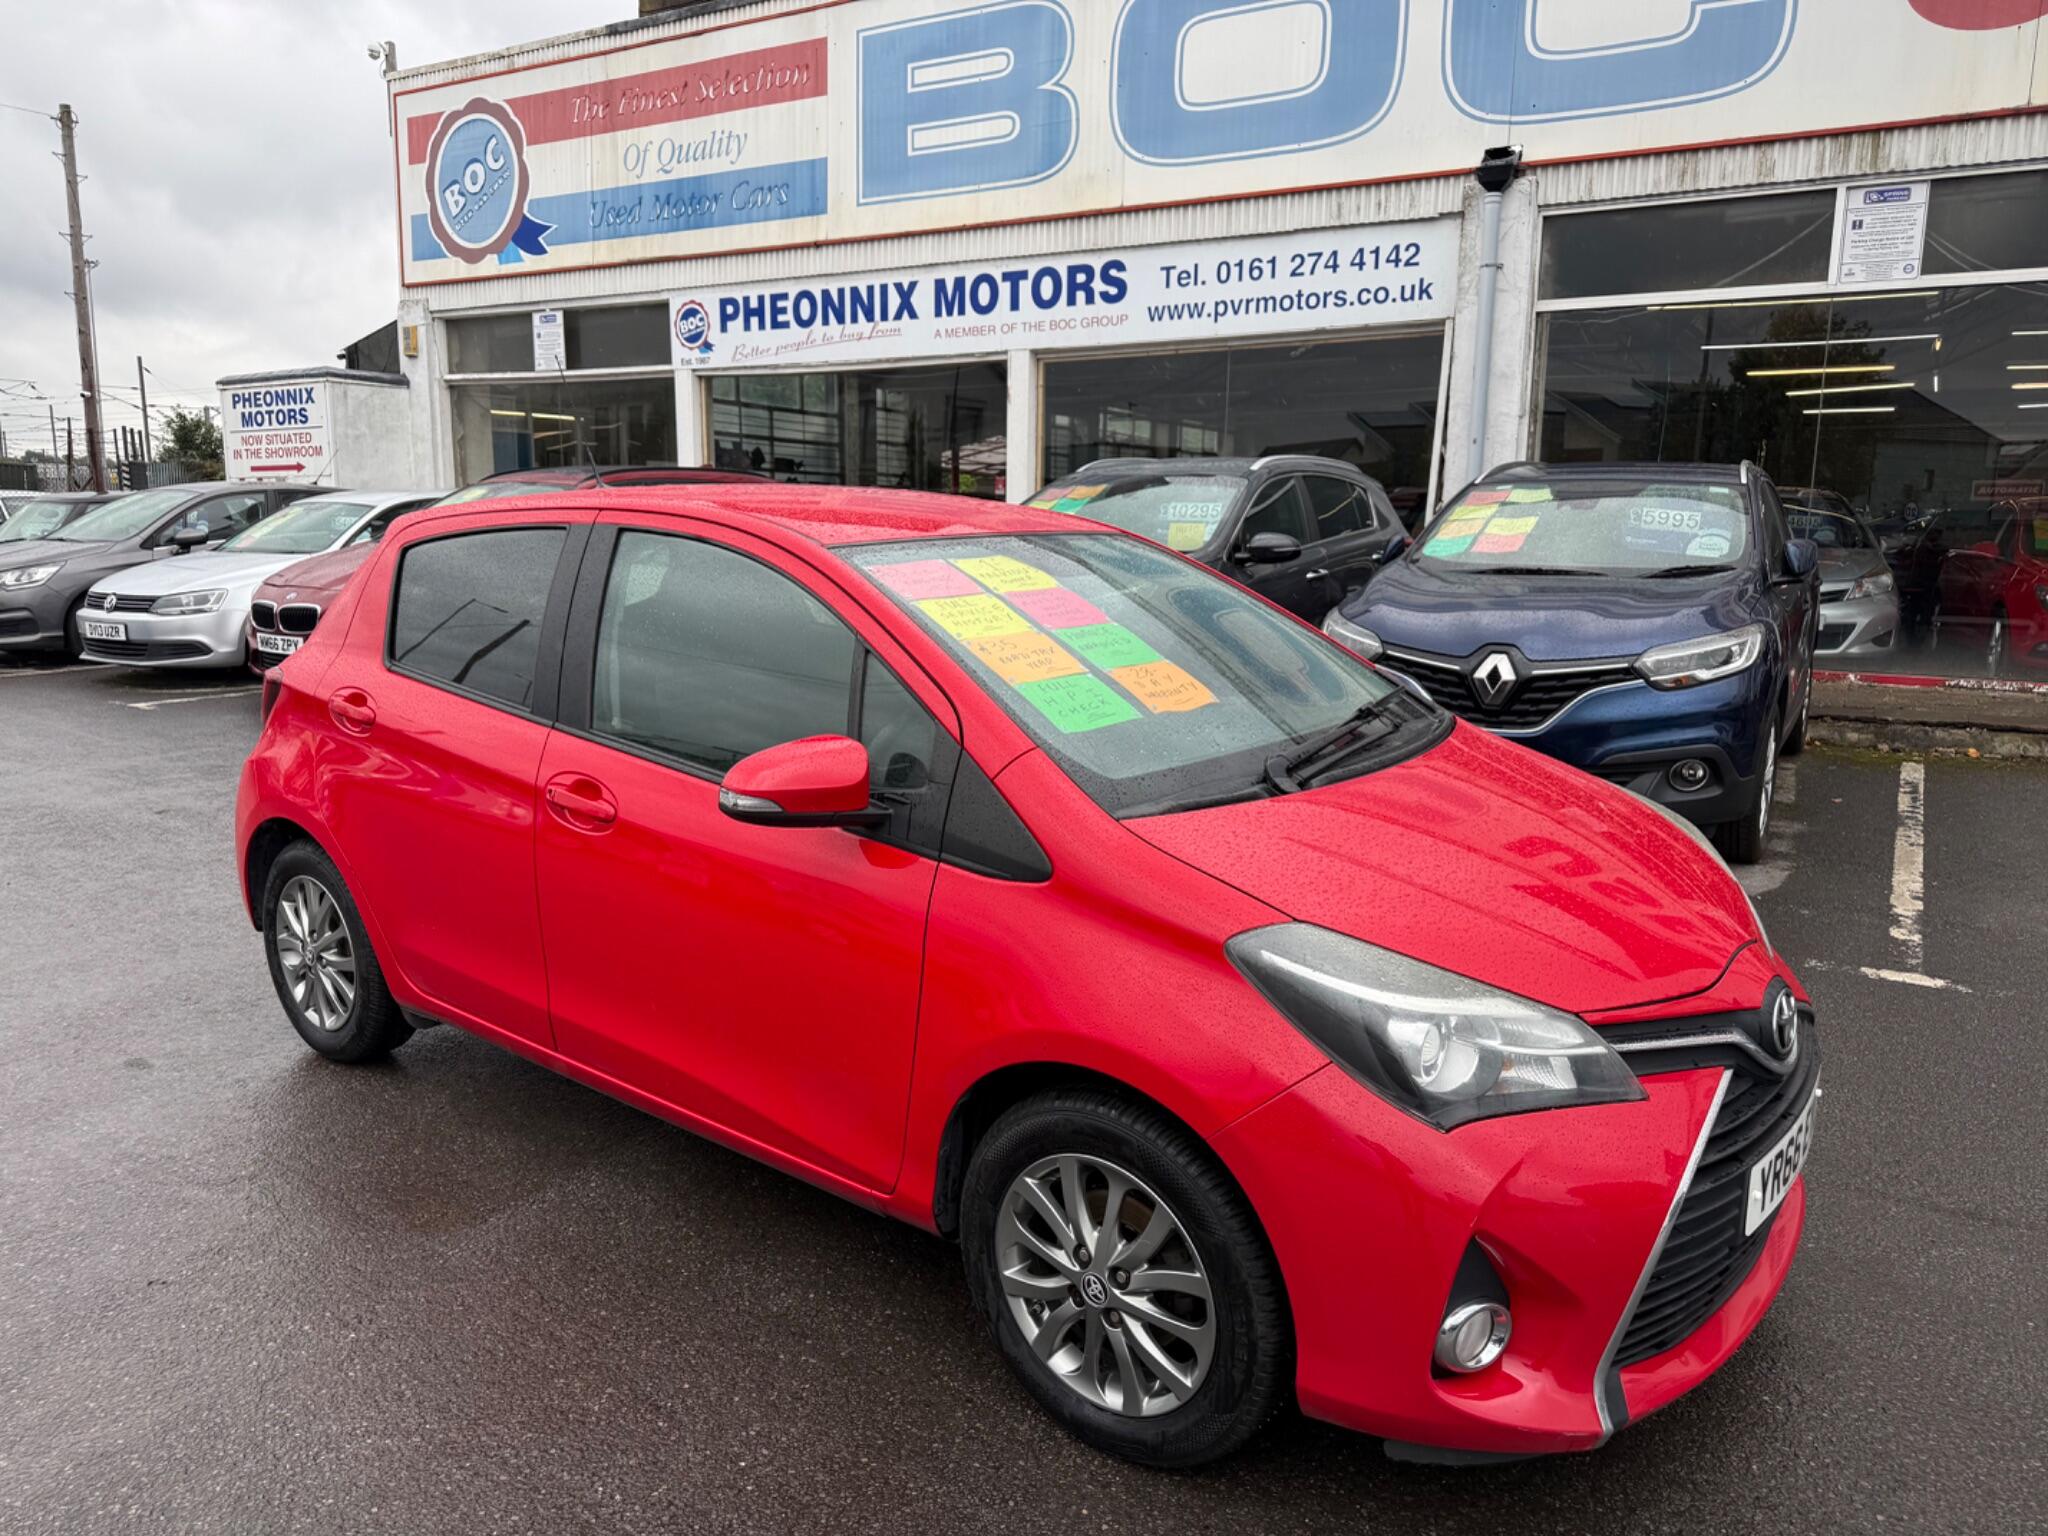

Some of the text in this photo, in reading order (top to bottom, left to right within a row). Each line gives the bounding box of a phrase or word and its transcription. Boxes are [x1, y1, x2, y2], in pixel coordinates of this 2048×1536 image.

[571, 62, 810, 123] The Finest Selection
[623, 130, 748, 179] Of Quality
[443, 134, 506, 220] BOC
[589, 180, 790, 228] Used Motor Cars
[1160, 242, 1421, 289] Tel. 0161 274 4142
[719, 259, 1128, 333] PHEONNIX MOTORS
[1147, 278, 1433, 323] www.pvrmotors.co.uk
[680, 313, 705, 333] BOC
[732, 321, 902, 362] Better people to buy from
[934, 314, 1129, 339] A MEMBER OF THE BOC GROUP
[232, 387, 315, 409] PHEONNIX
[241, 407, 309, 428] MOTORS
[234, 445, 323, 460] IN THE SHOWROOM
[241, 432, 312, 446] NOW SITUATED
[1977, 485, 2039, 495] AUTOMATIC
[1761, 1124, 1803, 1213] YR66
